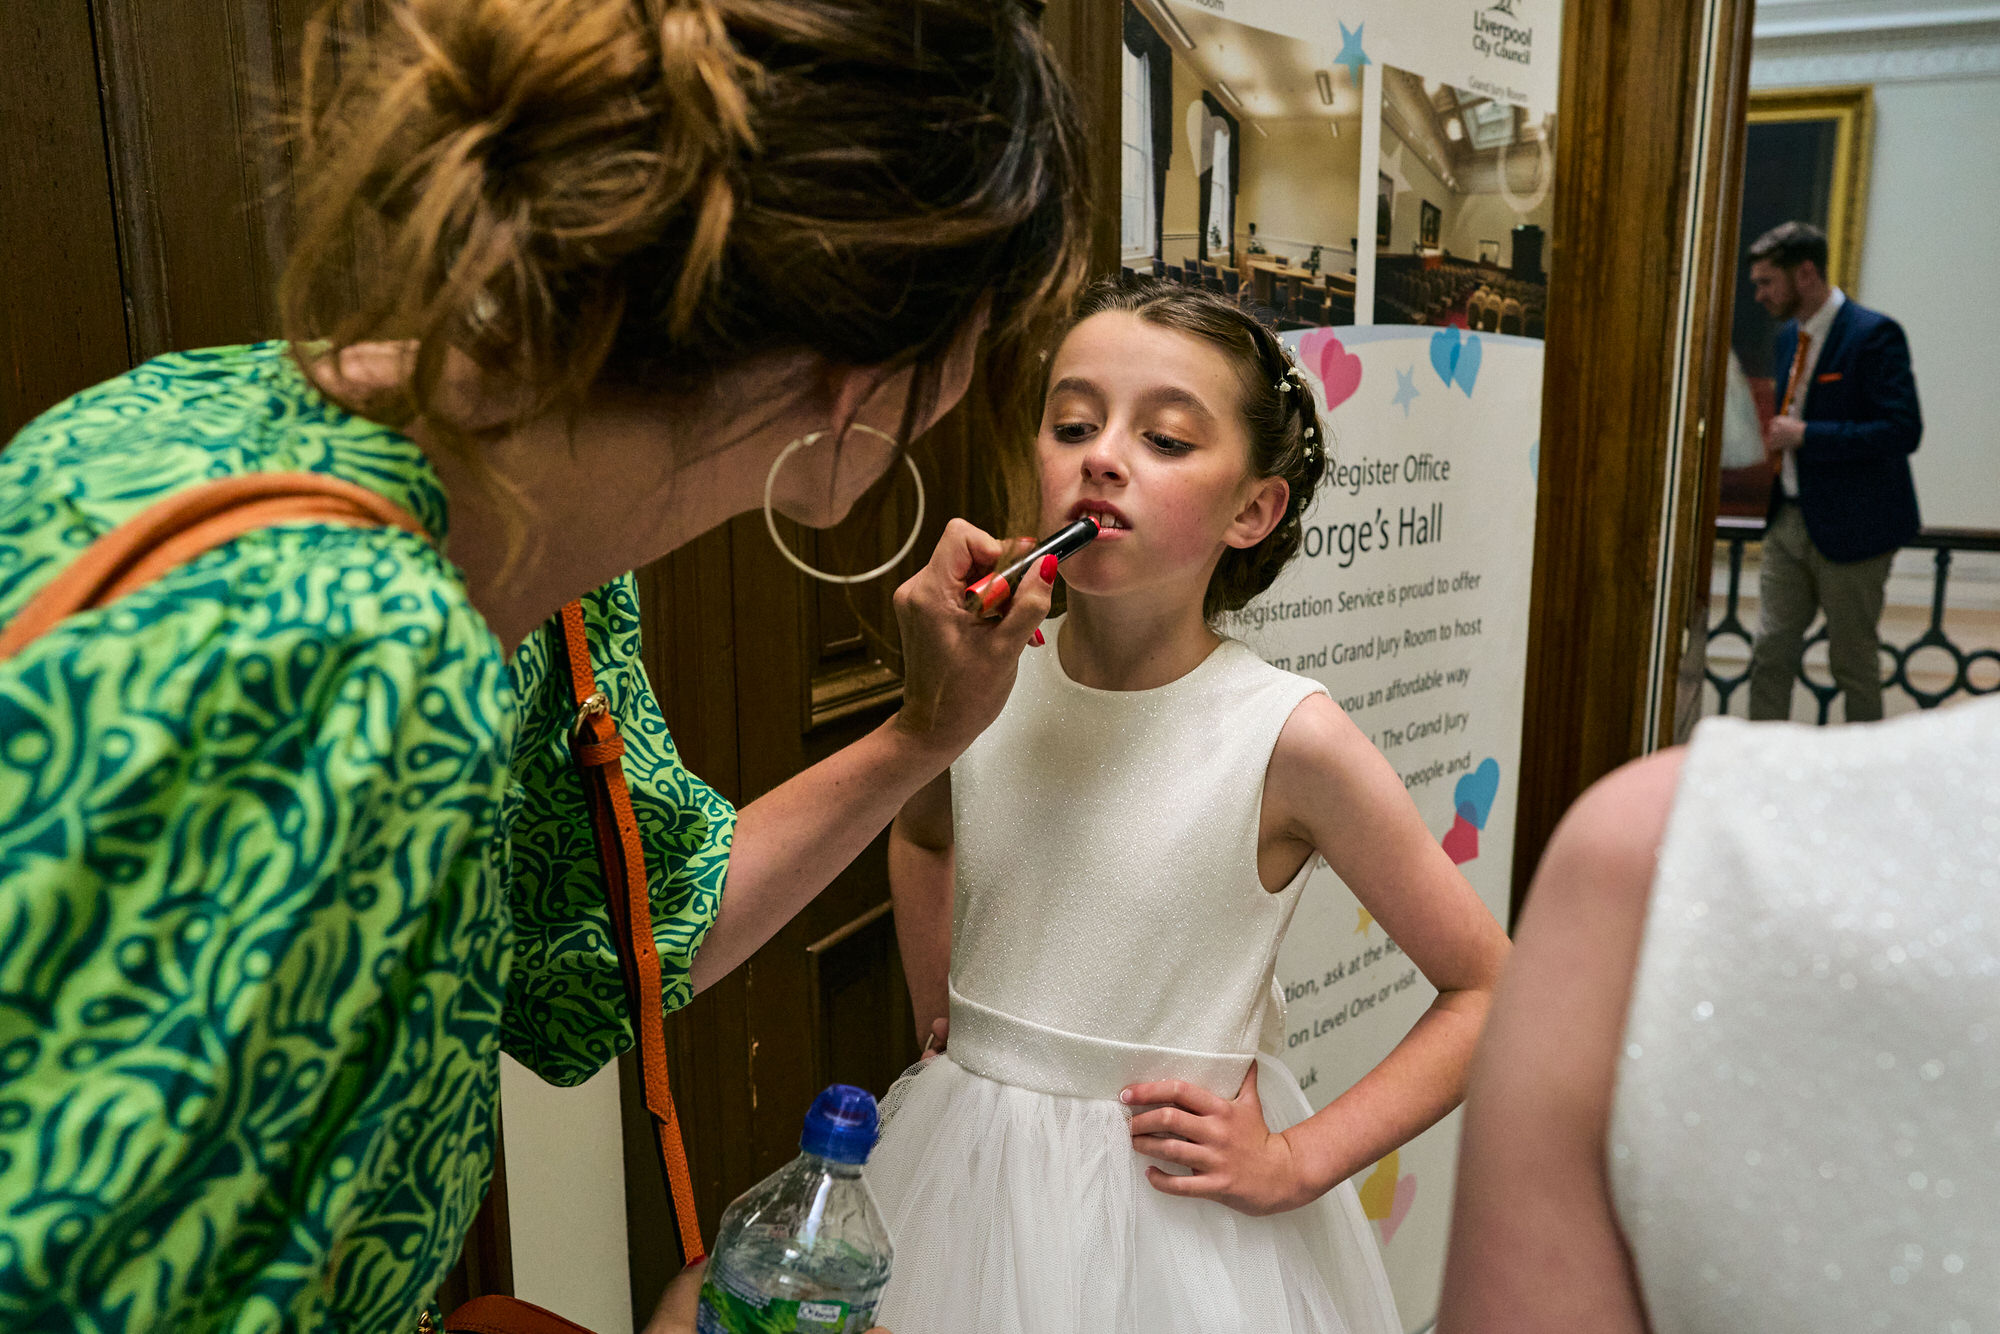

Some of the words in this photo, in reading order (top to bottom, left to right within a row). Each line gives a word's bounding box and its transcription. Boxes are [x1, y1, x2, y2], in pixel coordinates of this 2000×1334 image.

[1196, 0, 1224, 12] oom
[1474, 10, 1532, 47] Liverpool
[1473, 34, 1491, 57] City
[1494, 41, 1531, 65] Council
[1324, 456, 1399, 495] Register
[1403, 453, 1450, 483] Office
[1304, 507, 1389, 568] orge's
[1399, 502, 1443, 547] Hall
[1338, 589, 1385, 612] Service
[1387, 584, 1397, 602] is
[1399, 577, 1434, 607] proud
[1437, 575, 1449, 594] to
[1451, 571, 1482, 592] offer
[1296, 645, 1327, 671] and
[1331, 637, 1374, 665] Grand
[1376, 634, 1402, 660] Jury
[1404, 629, 1437, 650] Room
[1439, 623, 1451, 640] to
[1454, 618, 1482, 638] host
[1367, 688, 1383, 707] an
[1385, 672, 1443, 702] affordable
[1446, 667, 1470, 688] way
[1382, 728, 1404, 750] The
[1406, 713, 1442, 742] Grand
[1443, 712, 1469, 735] Jury
[1405, 761, 1445, 790] people
[1446, 751, 1471, 775] and
[1285, 979, 1319, 1003] tion,
[1324, 961, 1345, 988] ask
[1348, 955, 1361, 976] at
[1363, 946, 1382, 968] the
[1288, 1030, 1310, 1050] on
[1313, 1009, 1349, 1040] Level
[1351, 998, 1376, 1018] One
[1377, 986, 1392, 1003] or
[1393, 968, 1417, 994] visit
[1300, 1067, 1318, 1091] uk
